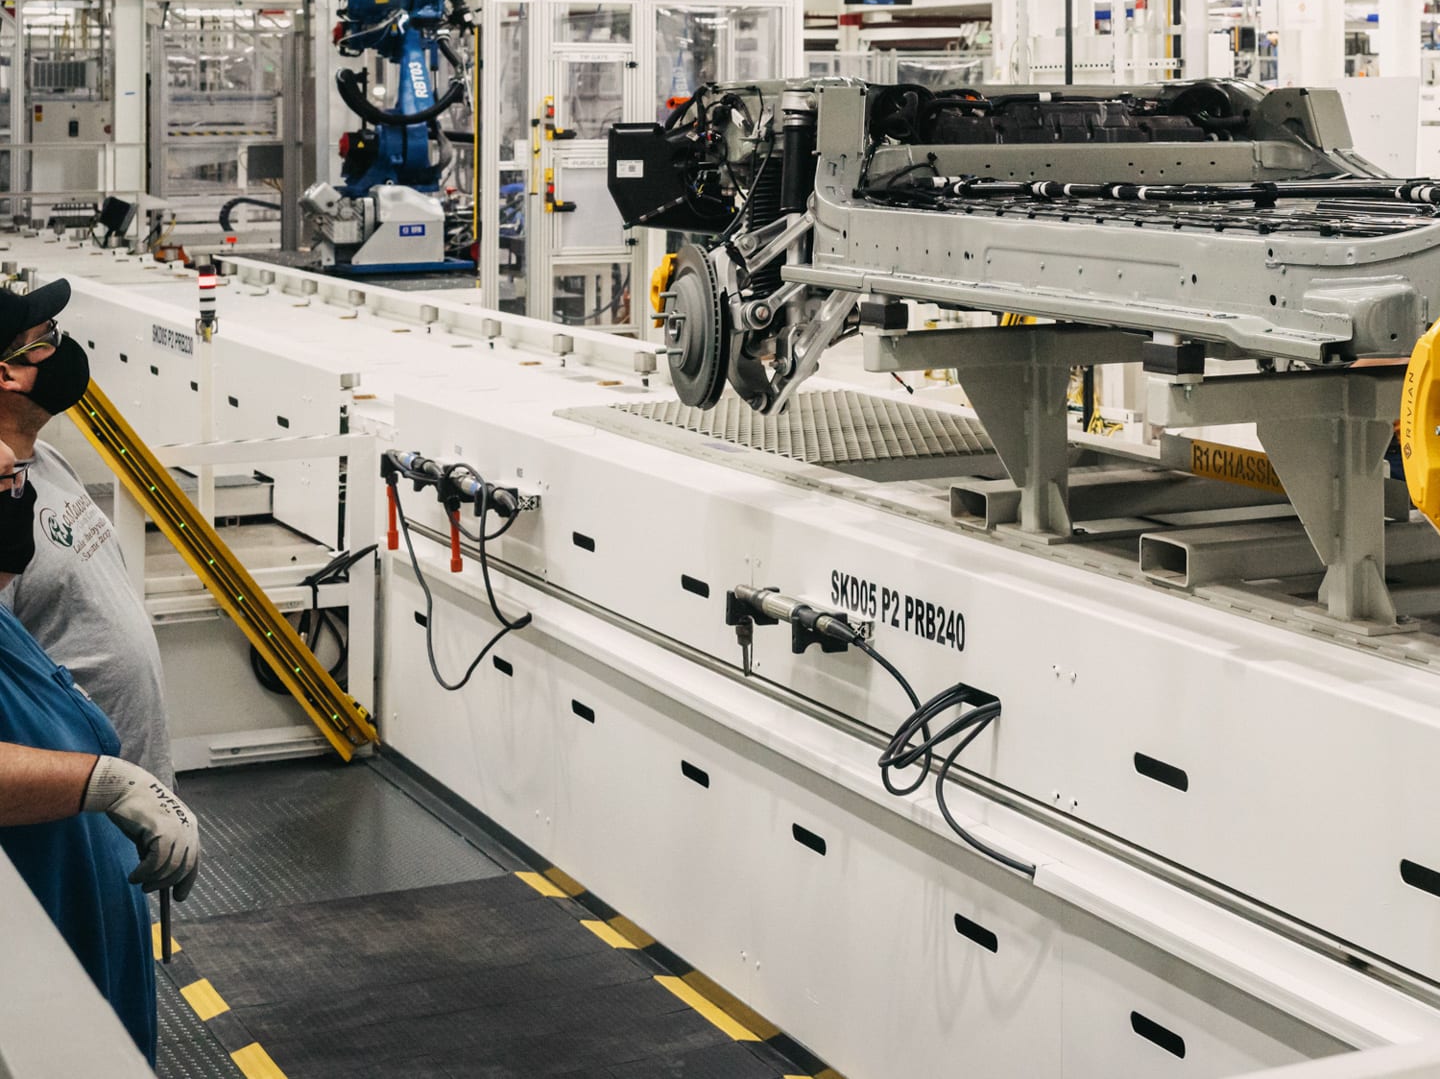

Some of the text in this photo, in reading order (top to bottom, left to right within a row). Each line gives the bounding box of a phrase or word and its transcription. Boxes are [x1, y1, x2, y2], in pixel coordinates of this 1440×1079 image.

[408, 61, 429, 98] RBT03
[1406, 372, 1414, 438] RIVIAN
[831, 570, 965, 652] SKD05 P2 PRB240
[149, 783, 189, 825] HyFlex
